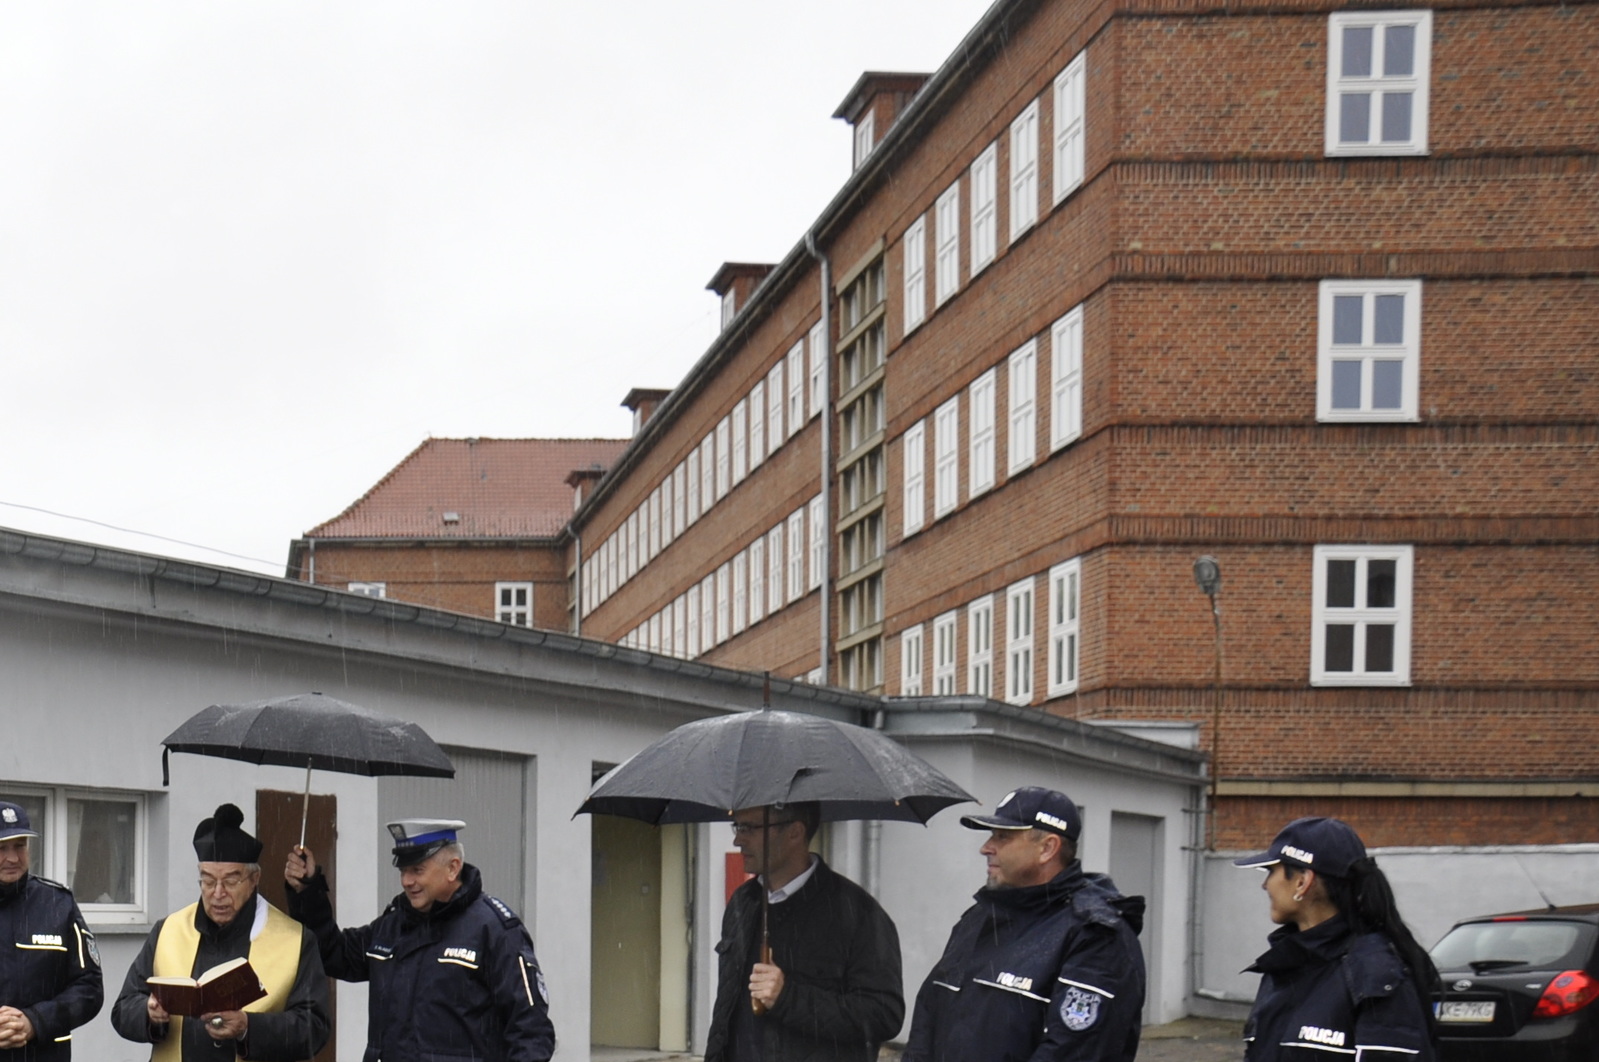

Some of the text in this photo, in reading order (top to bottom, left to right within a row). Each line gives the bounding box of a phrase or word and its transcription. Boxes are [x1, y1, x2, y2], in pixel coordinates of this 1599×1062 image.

[1035, 811, 1068, 831] POLICJA
[1281, 845, 1314, 864] POLICJA
[31, 934, 63, 946] POLICJA
[443, 947, 477, 962] POLICJA
[996, 971, 1033, 991] POLICJA
[1298, 1025, 1345, 1047] POLICJA
